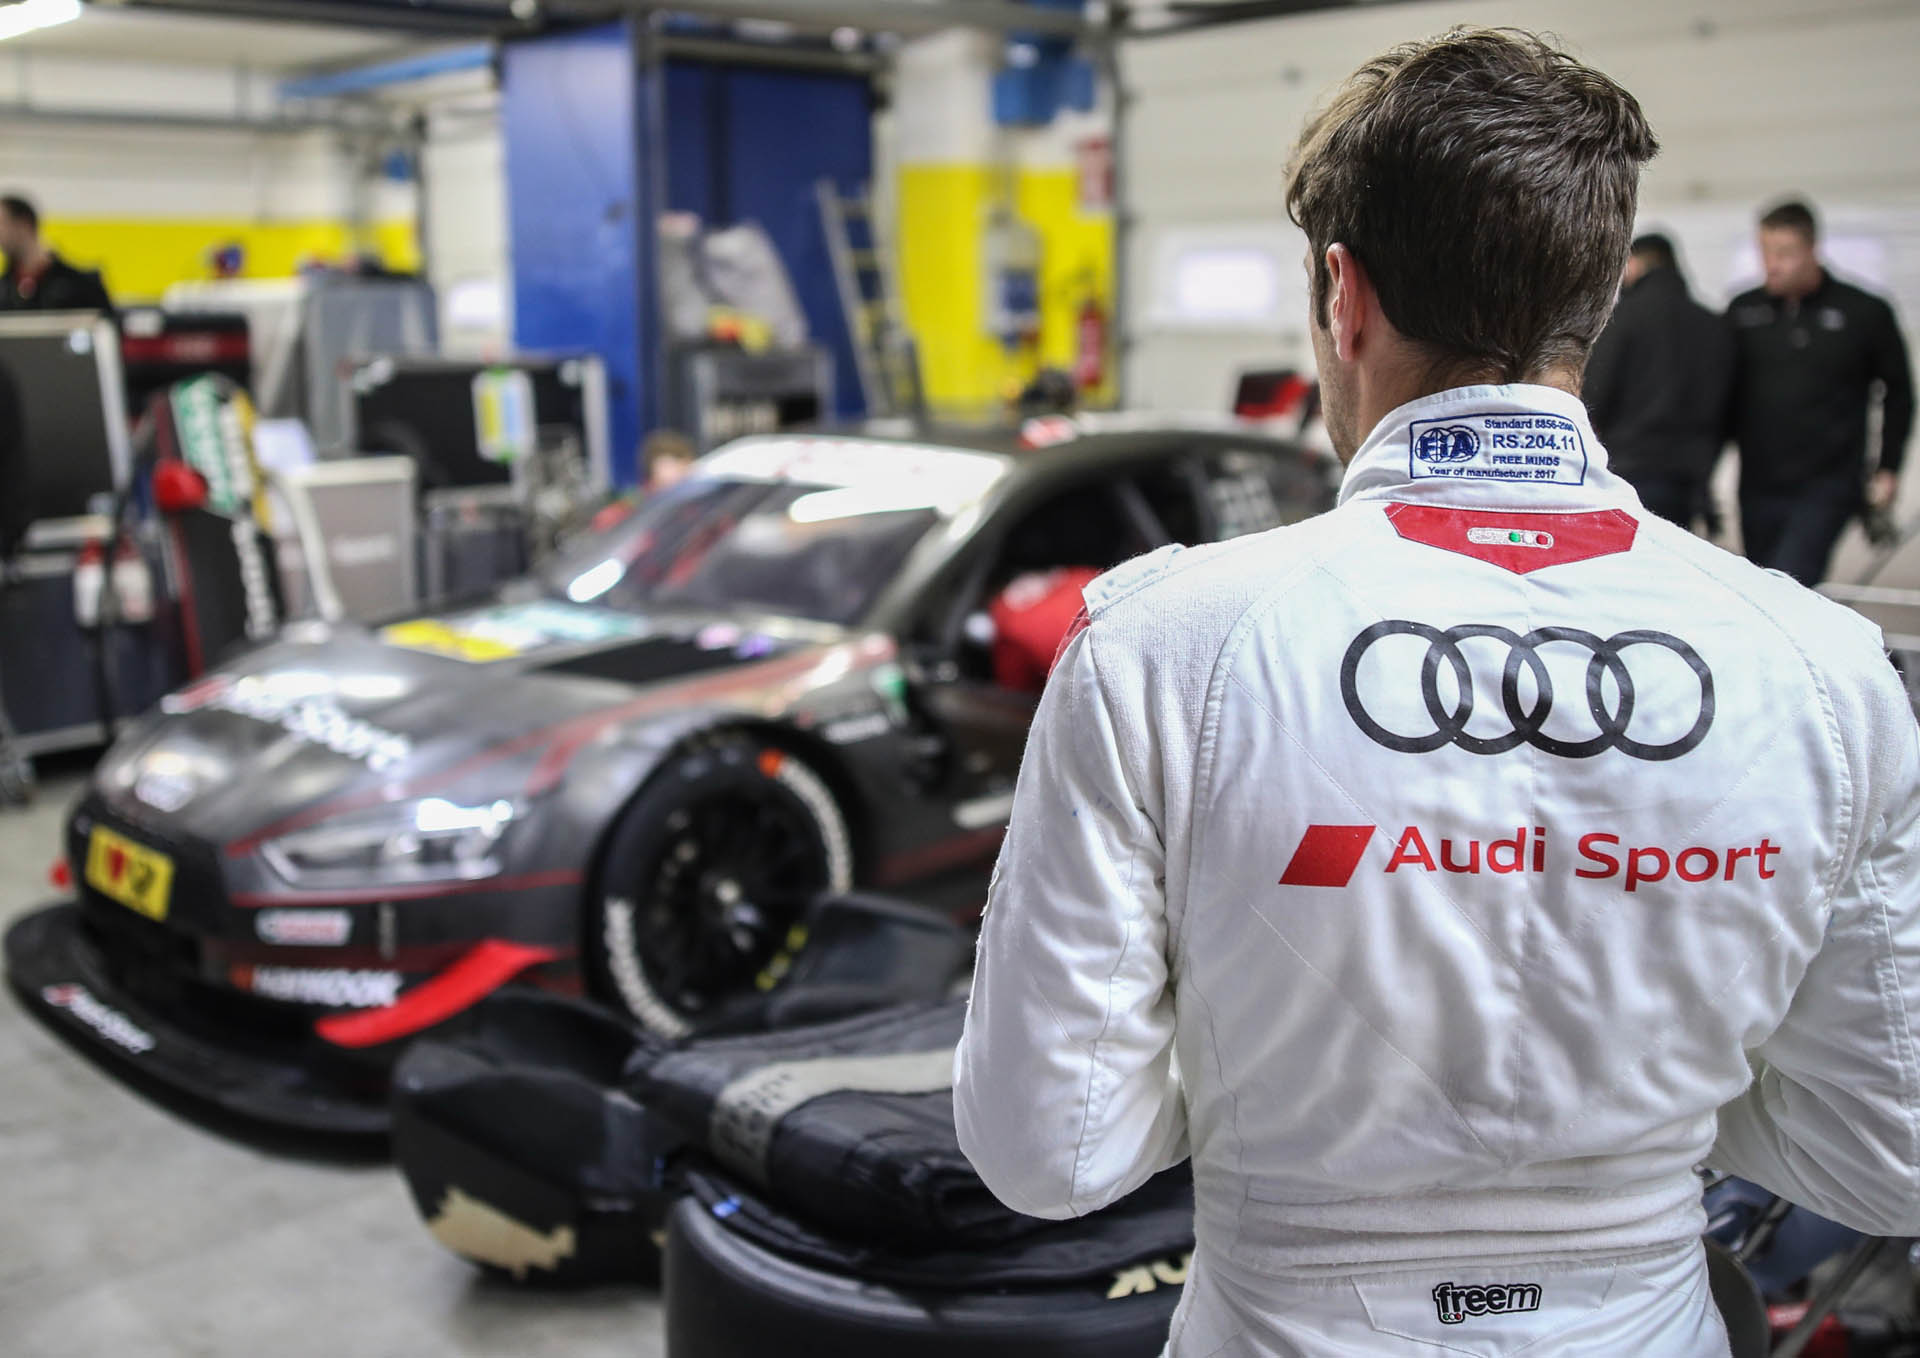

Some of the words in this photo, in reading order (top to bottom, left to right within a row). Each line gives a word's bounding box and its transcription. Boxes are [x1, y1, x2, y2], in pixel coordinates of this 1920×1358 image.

[1484, 418, 1533, 429] Standard
[1492, 433, 1576, 451] RS.204.11
[1492, 455, 1522, 465] FREE
[1525, 456, 1560, 466] MINDS
[1428, 466, 1452, 476] Year
[1453, 467, 1465, 476] of
[1466, 468, 1533, 478] manufacture:
[1534, 469, 1557, 479] 2017
[1384, 825, 1545, 874] Audi
[1574, 832, 1782, 892] Sport
[1436, 1284, 1540, 1313] freem
